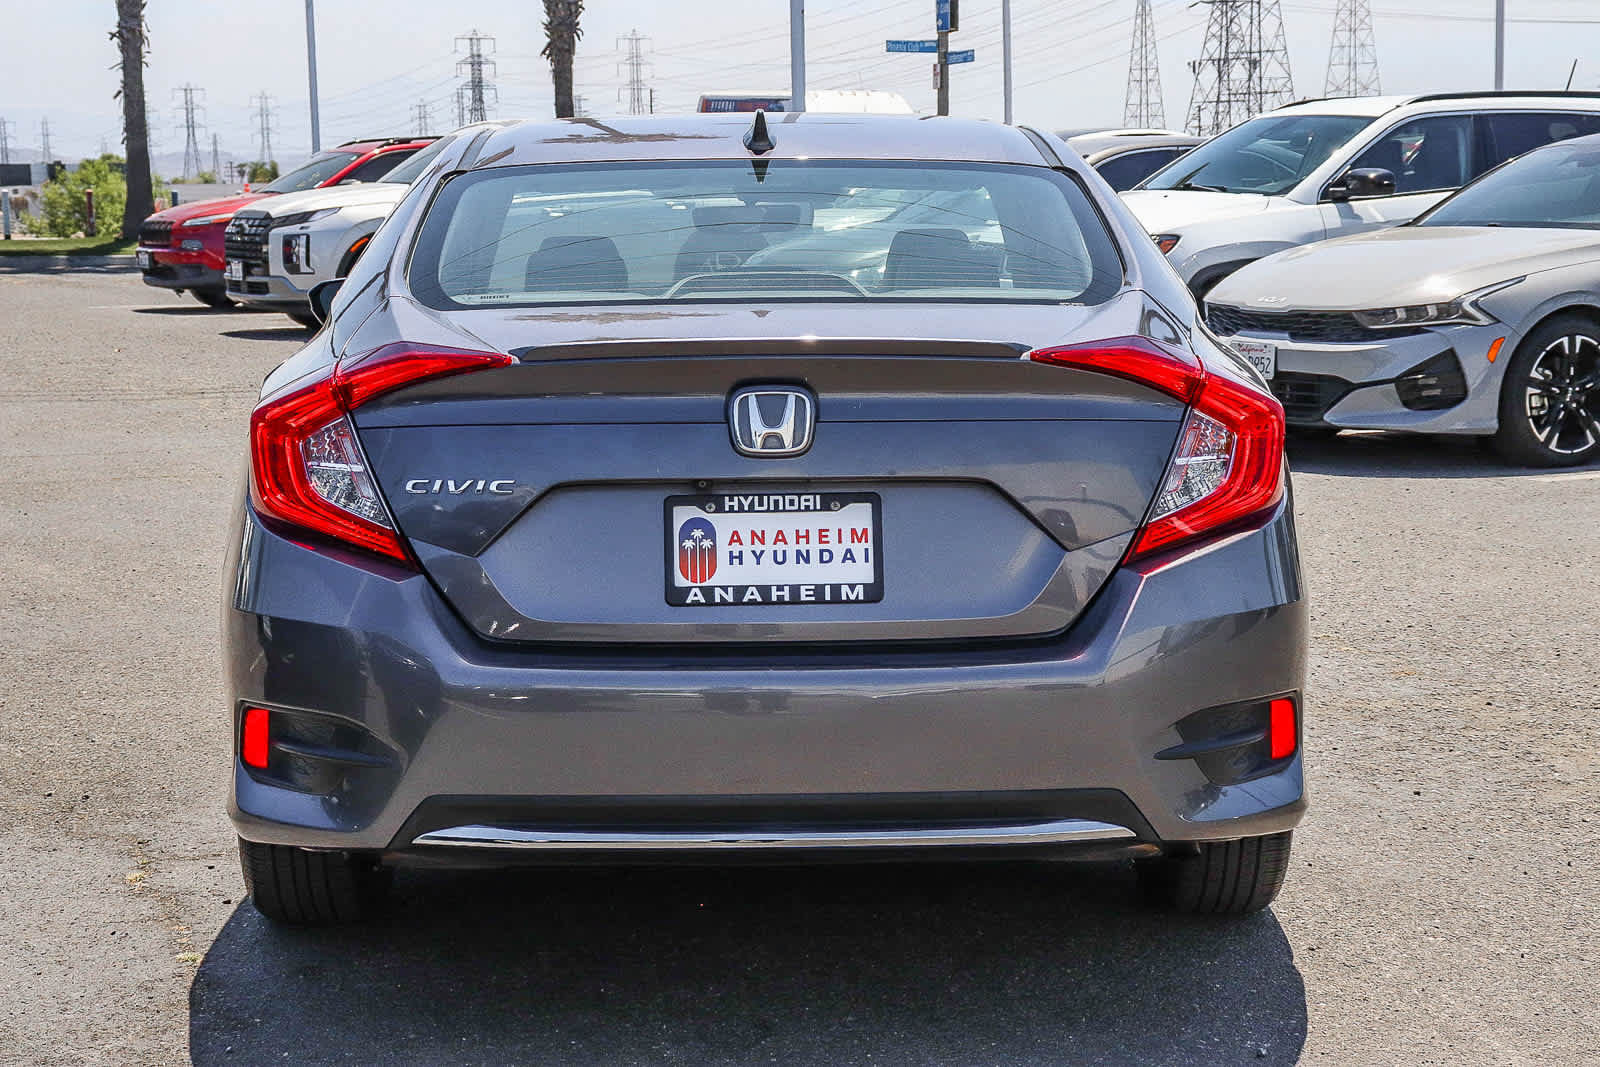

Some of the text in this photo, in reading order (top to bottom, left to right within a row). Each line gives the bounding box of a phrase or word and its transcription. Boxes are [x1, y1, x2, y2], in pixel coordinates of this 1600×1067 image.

[404, 478, 516, 495] CIVIC
[724, 495, 821, 512] HYUNDAI
[727, 527, 869, 546] ANAHEIM
[728, 547, 870, 566] HYUNDAI
[685, 584, 865, 604] ANAHEIM
